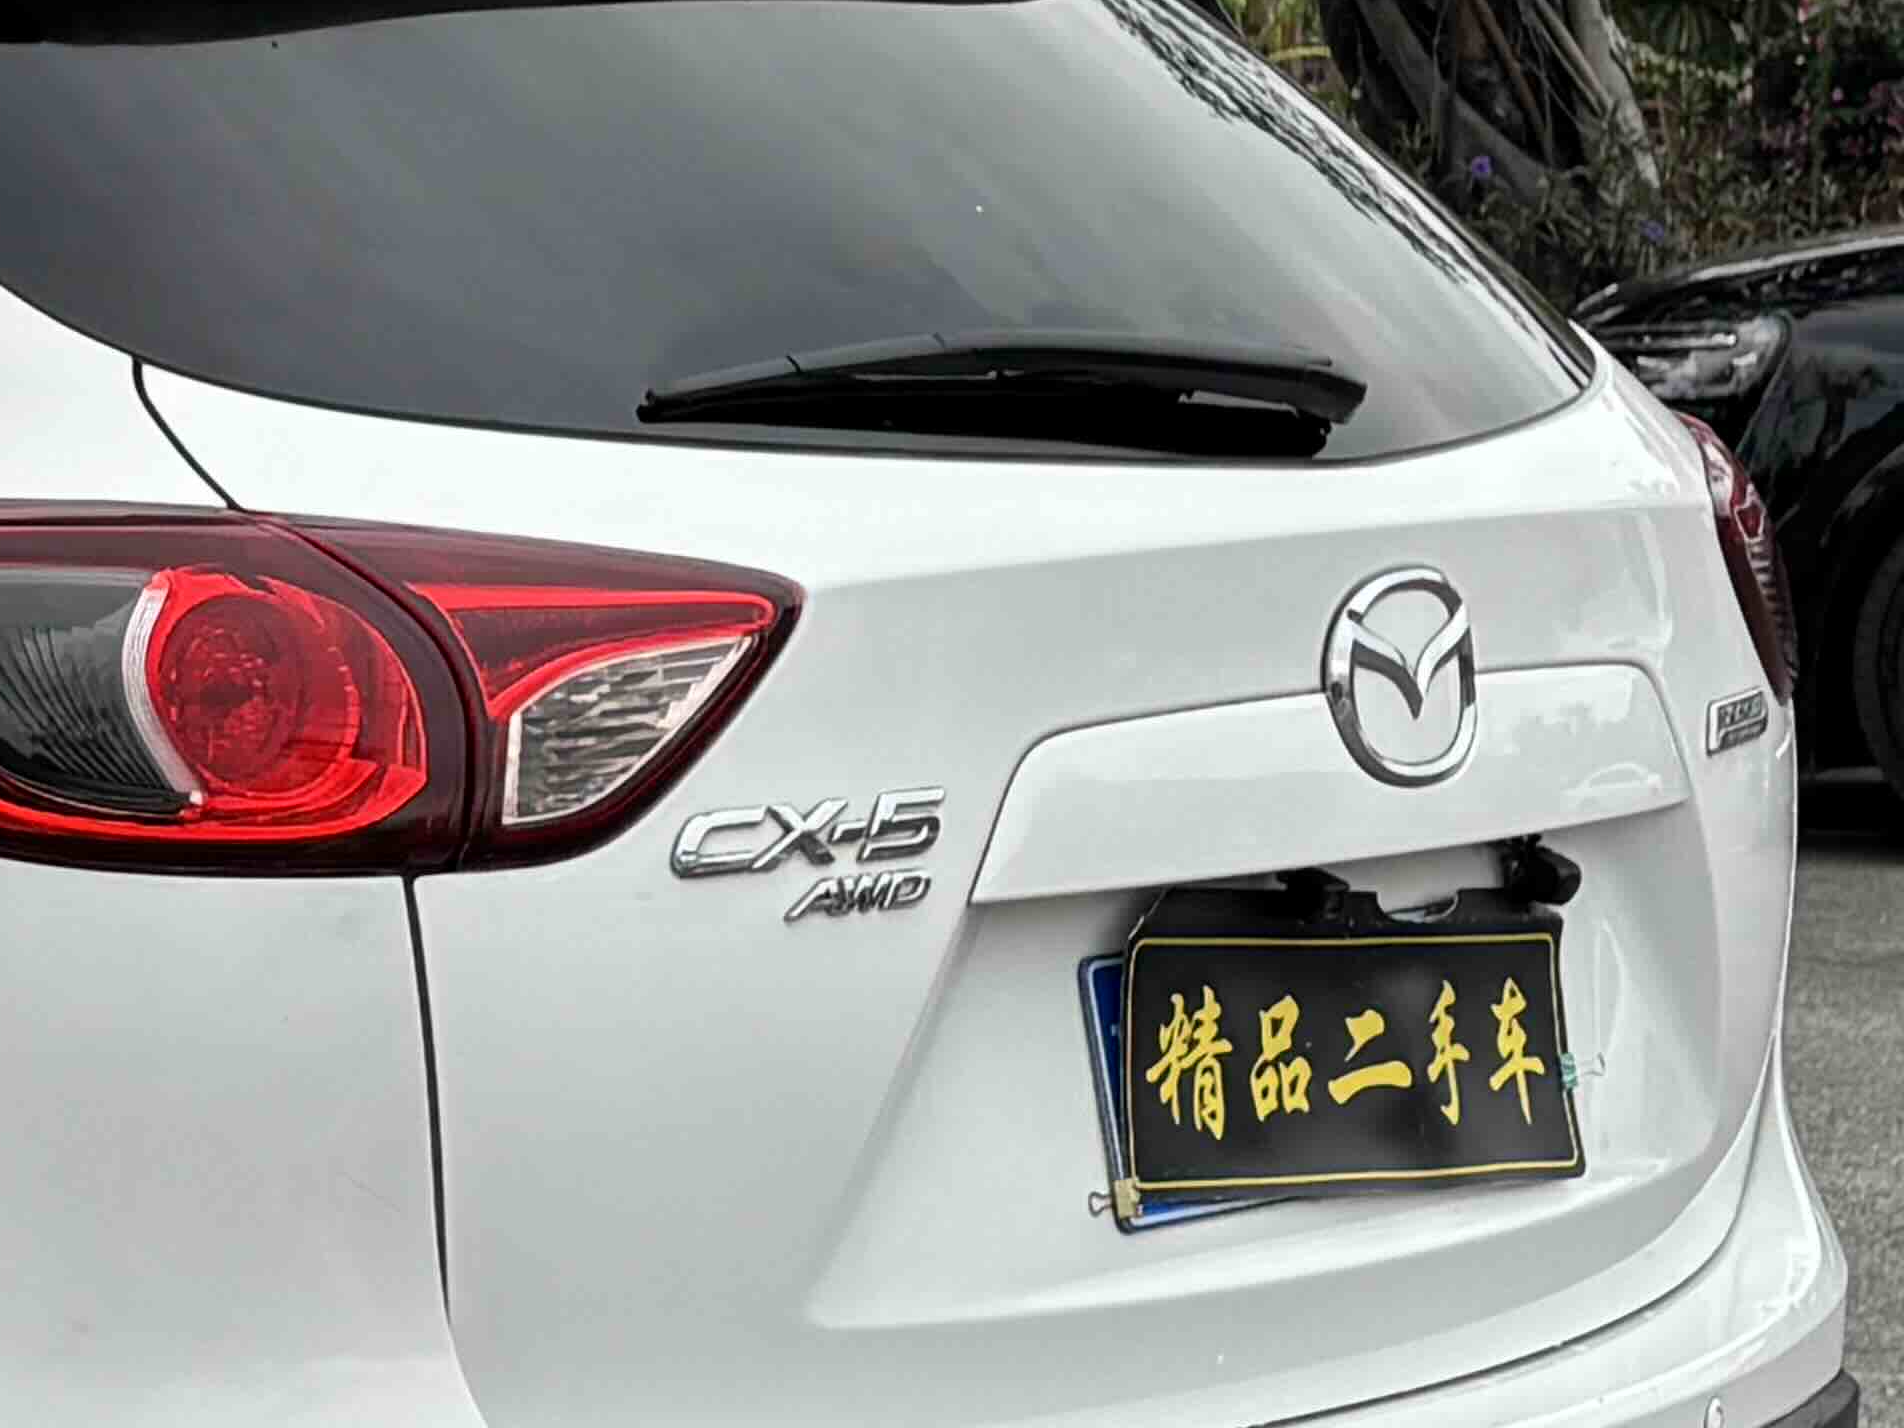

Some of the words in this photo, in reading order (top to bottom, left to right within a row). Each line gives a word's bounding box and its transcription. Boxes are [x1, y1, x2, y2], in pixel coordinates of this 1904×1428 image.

[670, 786, 946, 879] CX-5
[783, 870, 931, 922] AWD
[1145, 976, 1546, 1140] 精品二手车
